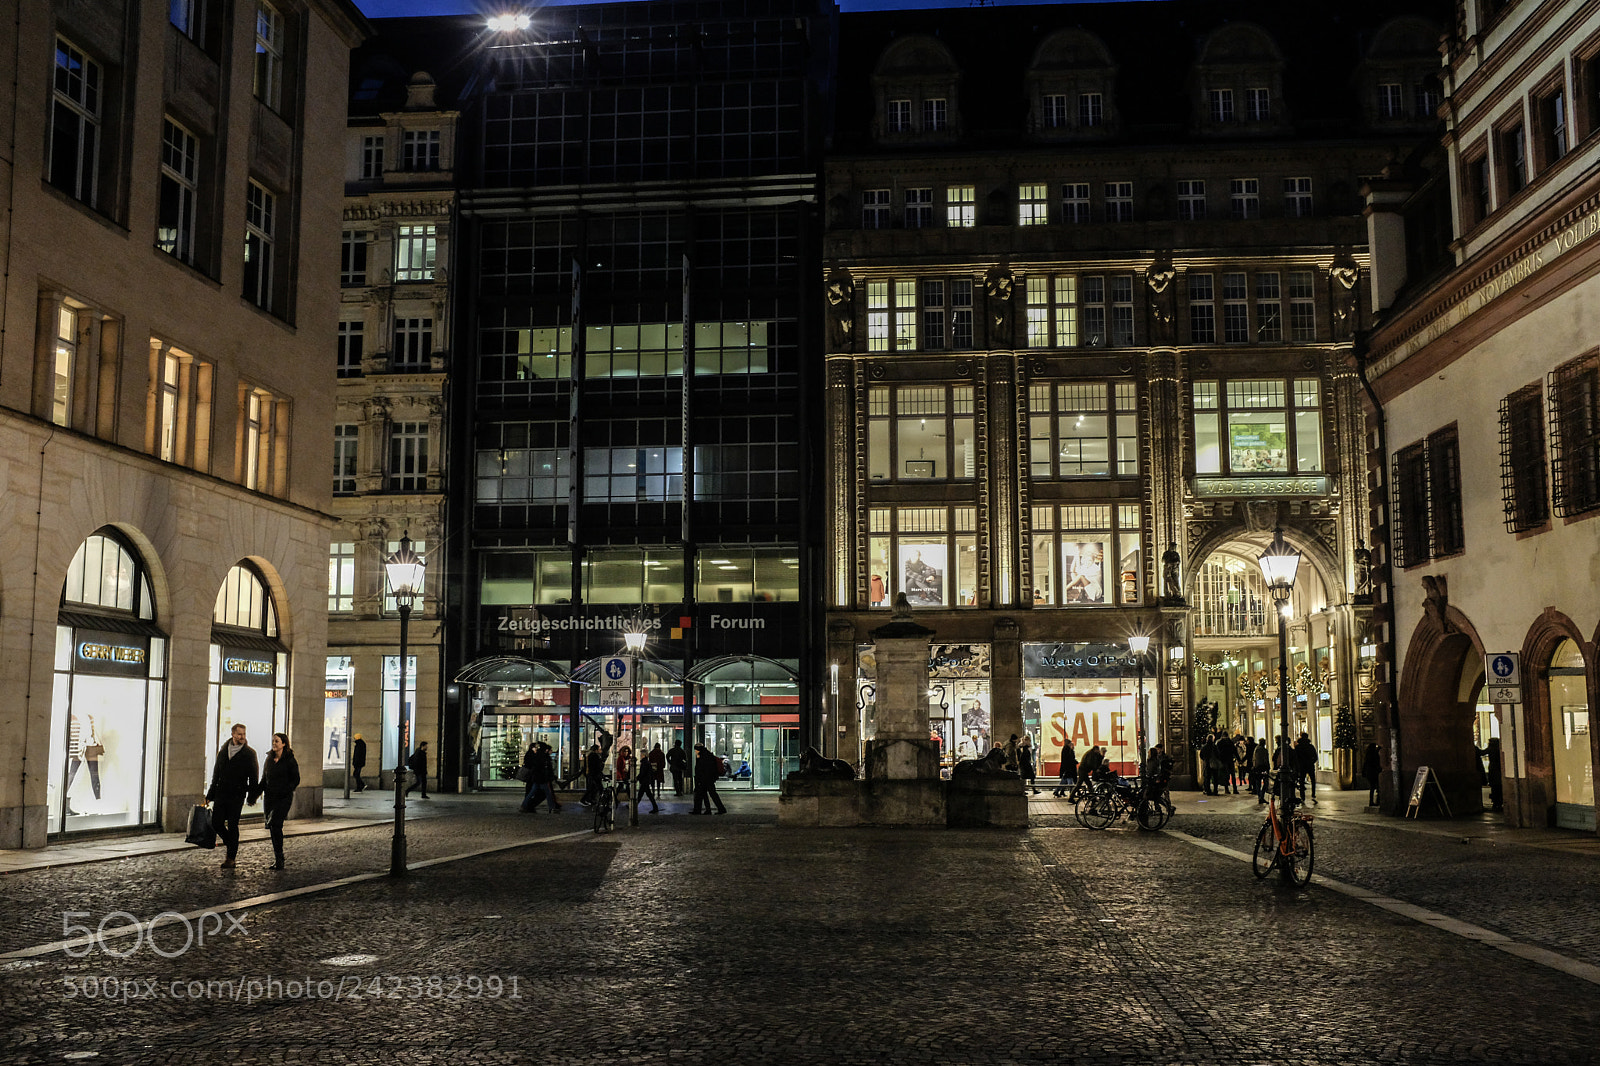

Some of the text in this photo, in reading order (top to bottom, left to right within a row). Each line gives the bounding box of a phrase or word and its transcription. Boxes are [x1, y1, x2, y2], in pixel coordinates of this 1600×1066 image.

[1479, 249, 1543, 307] NOVEMBRIS
[1261, 481, 1318, 493] PASSAGE
[710, 614, 766, 629] Forum
[82, 642, 145, 663] GERRY WEBER
[228, 658, 273, 674] GERRY WEBER
[1041, 656, 1084, 668] Marc
[1051, 712, 1128, 747] SALE
